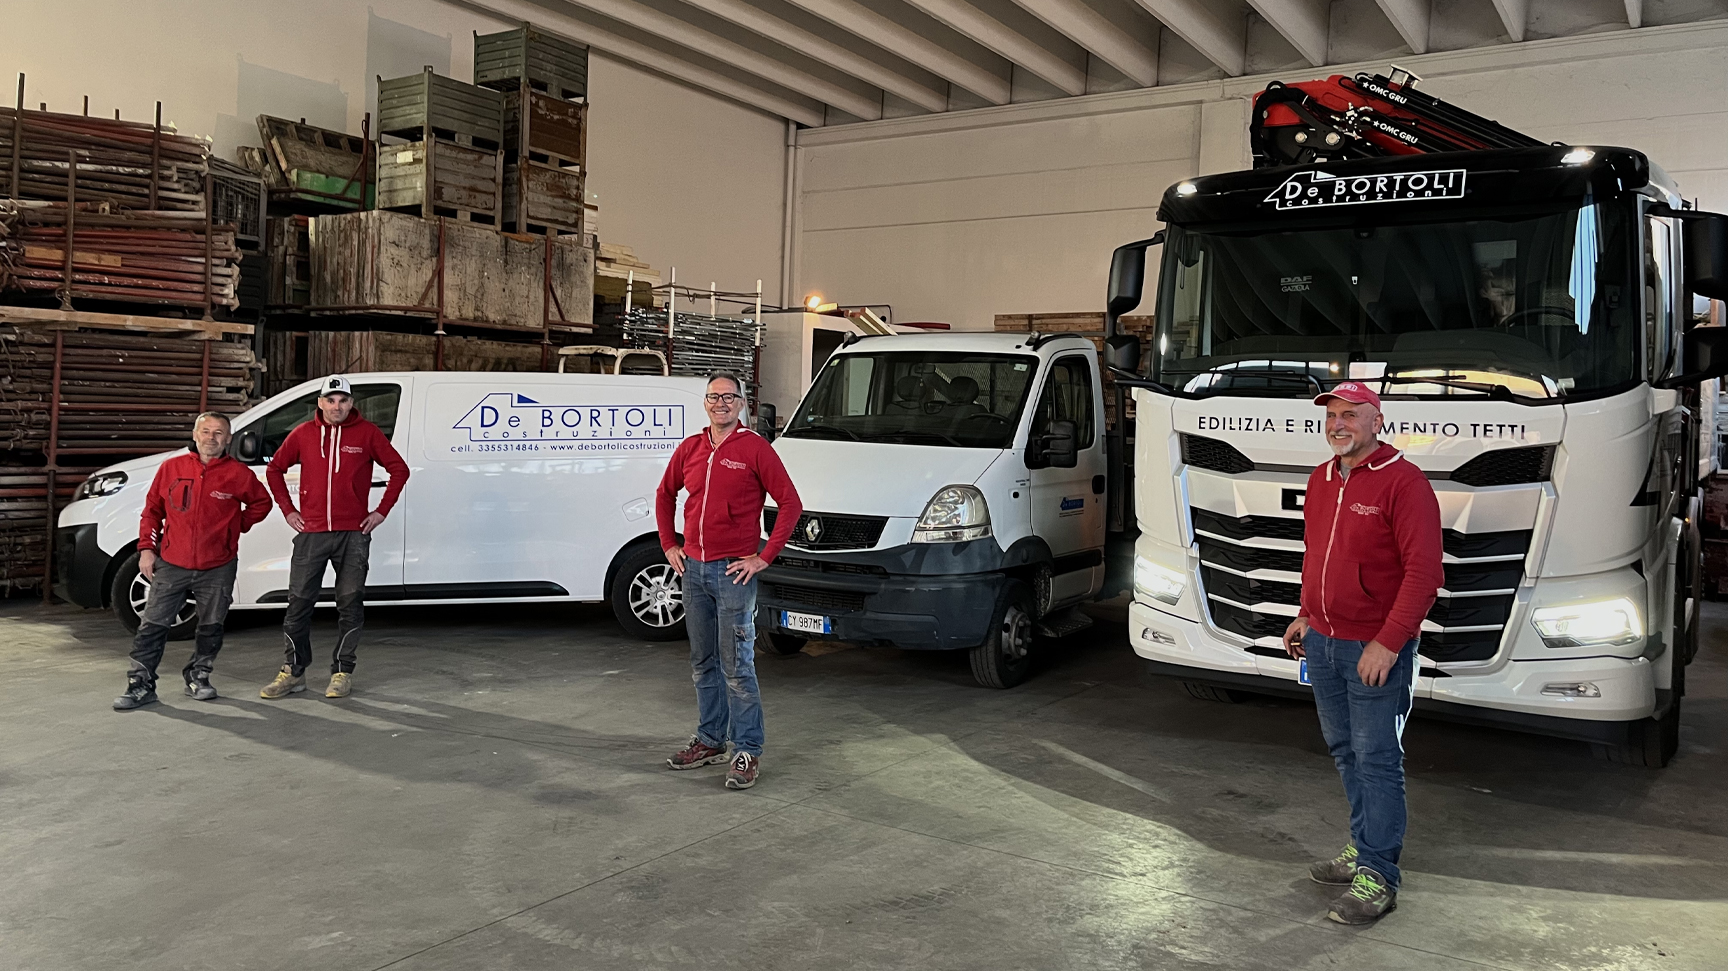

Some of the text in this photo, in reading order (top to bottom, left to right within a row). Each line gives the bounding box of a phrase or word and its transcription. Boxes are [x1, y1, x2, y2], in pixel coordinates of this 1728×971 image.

[1369, 84, 1407, 104] OMC GRU
[1380, 123, 1418, 144] OMC GRU
[1285, 173, 1454, 199] De BORTOLI
[1286, 187, 1447, 207] costruzioni
[1281, 275, 1312, 283] DAF
[480, 406, 672, 428] De BORTOLI
[483, 427, 666, 439] costruzioni
[1198, 416, 1525, 439] EDILIZIA E RIMENTO TETTI
[450, 444, 473, 453] cell.
[478, 443, 539, 453] 3355314846
[550, 441, 680, 451] www.debortolicostruzioni
[788, 614, 797, 626] CY
